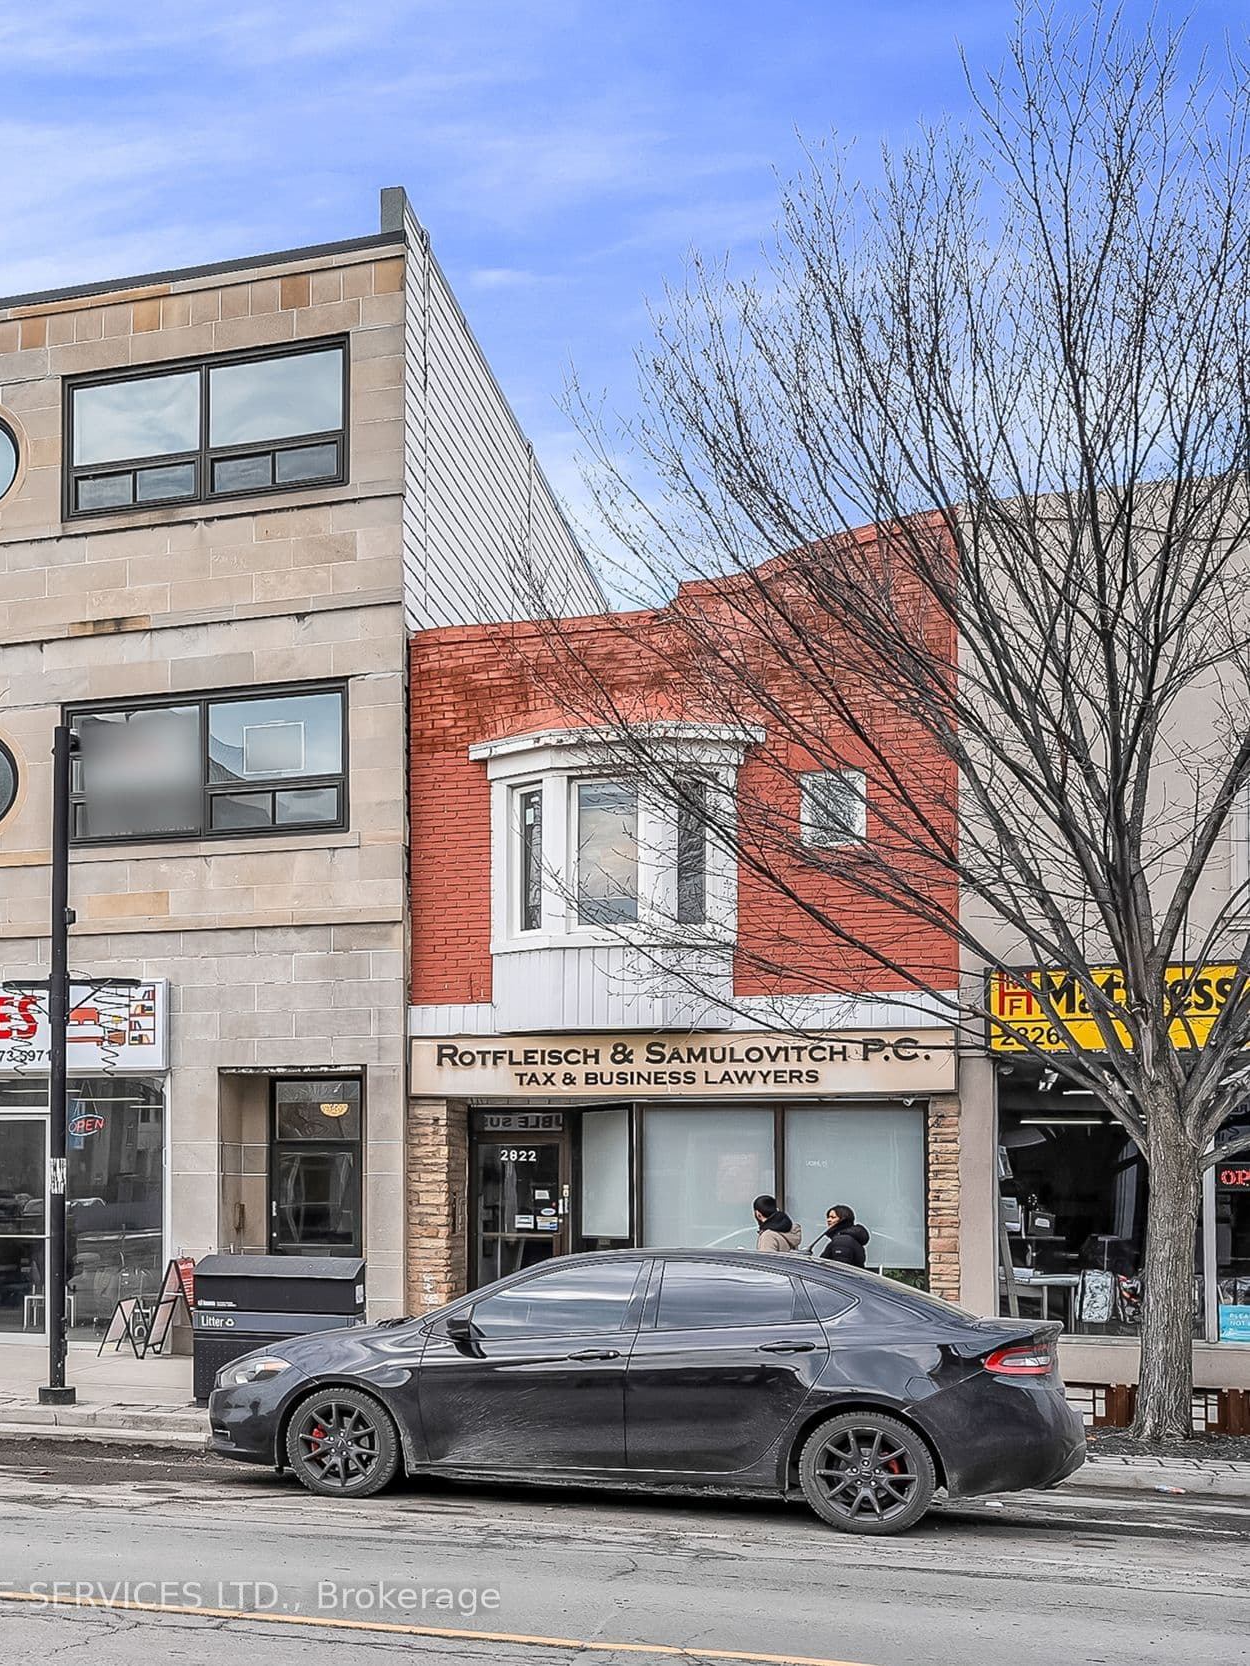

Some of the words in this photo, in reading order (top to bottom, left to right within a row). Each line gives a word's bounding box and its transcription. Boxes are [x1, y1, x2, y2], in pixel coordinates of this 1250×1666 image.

[610, 1042, 634, 1064] &
[862, 1037, 930, 1062] P.C.
[514, 1072, 556, 1086] TAX
[562, 1071, 577, 1086] &
[584, 1071, 696, 1085] BUSINESS
[704, 1069, 819, 1084] LAWYERS
[69, 1119, 105, 1132] OPEN
[500, 1150, 537, 1162] 2822
[201, 1315, 225, 1328] Litter
